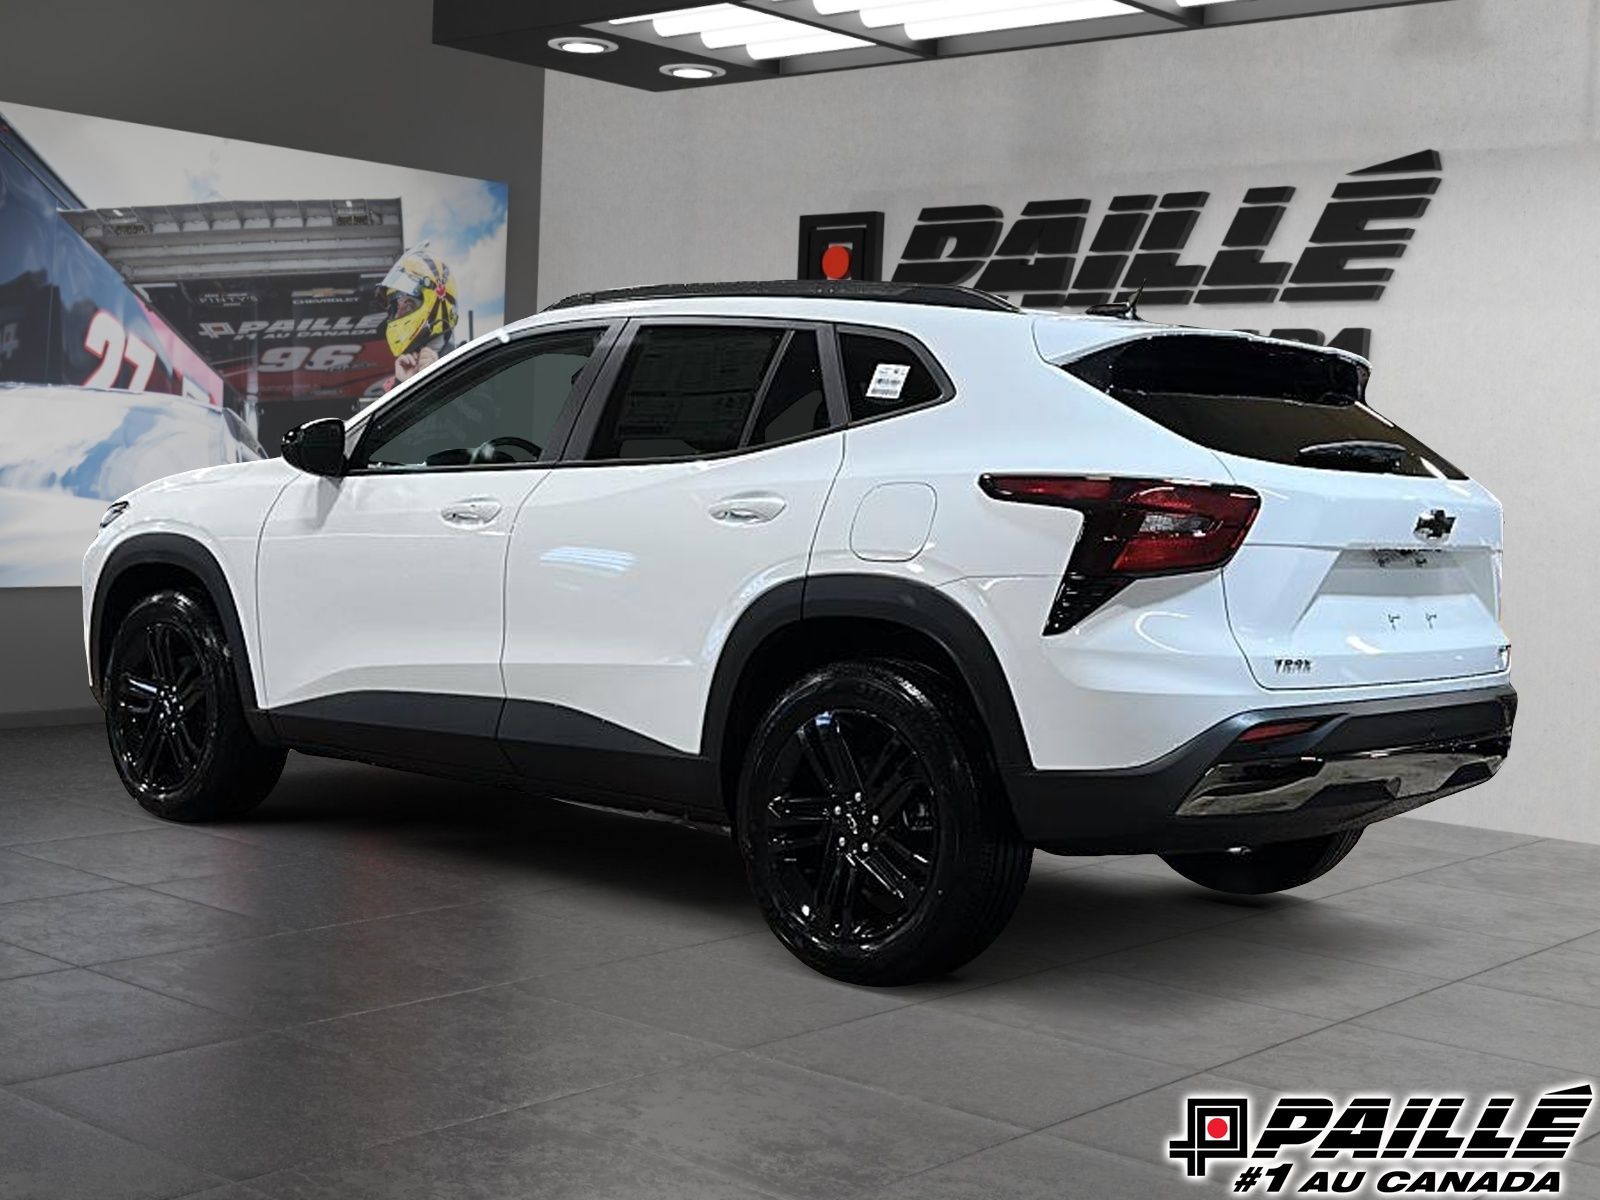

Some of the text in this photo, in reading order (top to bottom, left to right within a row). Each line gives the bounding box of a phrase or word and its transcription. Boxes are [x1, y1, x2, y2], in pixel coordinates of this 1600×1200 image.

[892, 149, 1442, 306] PAILLÉ
[292, 297, 359, 305] CHEVROLET
[263, 332, 291, 340] AU
[296, 329, 377, 338] CANADA
[81, 308, 157, 394] 27
[258, 344, 362, 373] 96
